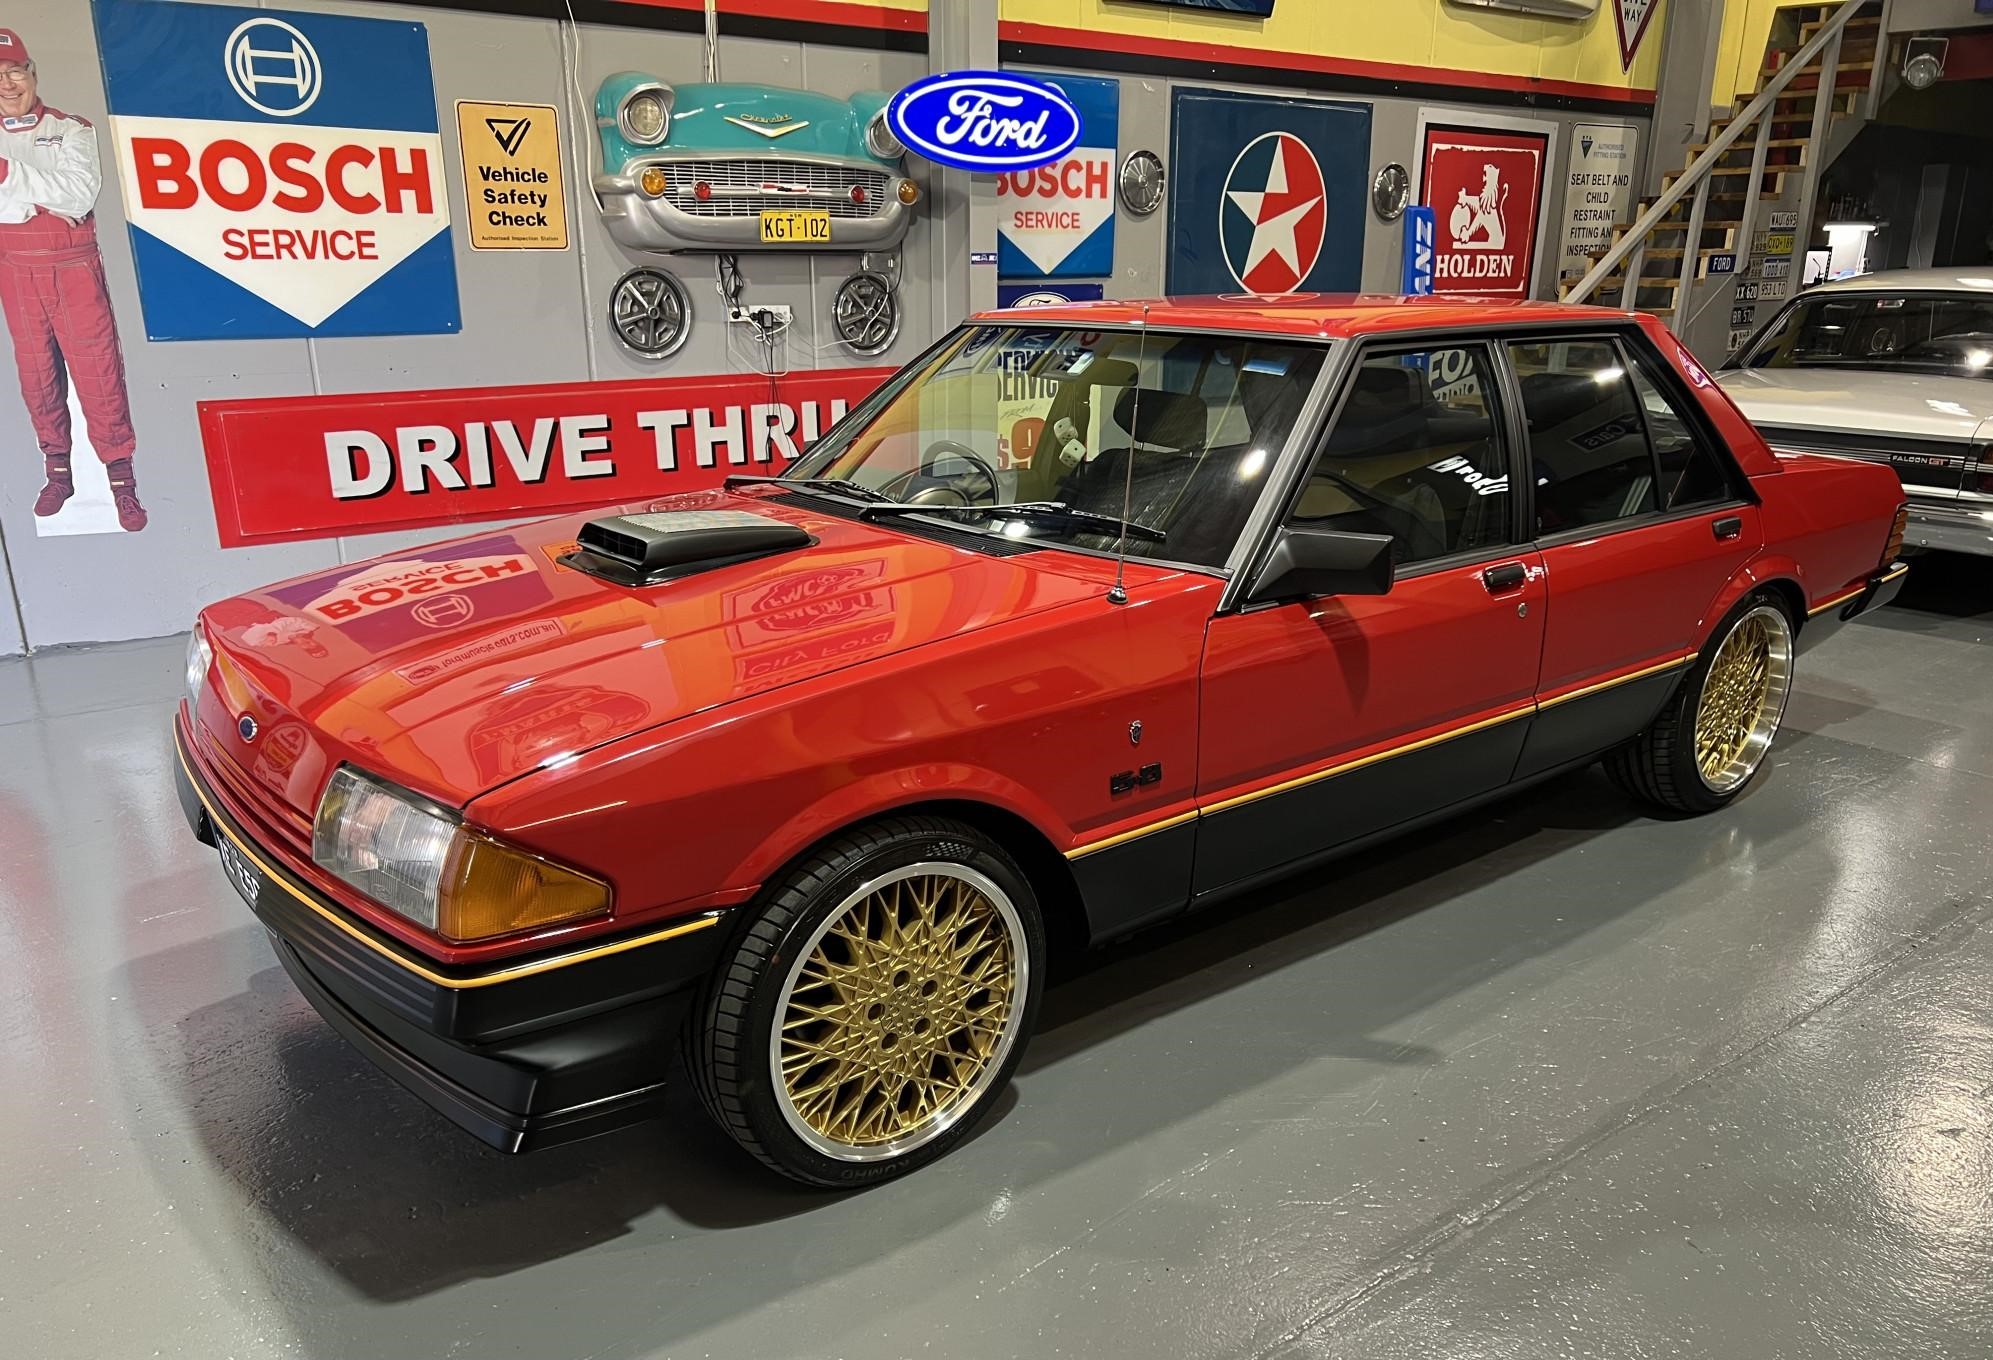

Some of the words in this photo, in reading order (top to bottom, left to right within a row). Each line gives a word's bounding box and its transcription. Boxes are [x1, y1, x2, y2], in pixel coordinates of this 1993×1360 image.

[1624, 8, 1643, 22] WAY
[936, 90, 1050, 149] Ford
[131, 137, 433, 214] BOSCH
[478, 165, 549, 184] Vehicle
[1570, 173, 1590, 186] SEAT
[1591, 174, 1611, 186] BELT
[1612, 174, 1629, 186] AND
[483, 188, 548, 209] Safety
[1586, 191, 1609, 204] CHILD
[488, 210, 548, 226] Check
[1014, 211, 1081, 229] SERVICE
[1573, 209, 1616, 222] RESTRAINT
[1570, 226, 1599, 239] FITTING
[1600, 226, 1612, 239] AN
[222, 228, 379, 260] SERVICE
[1434, 254, 1514, 279] HOLDEN
[1712, 257, 1731, 271] FORD
[324, 413, 614, 498] DRIVE
[637, 399, 846, 470] THRU
[1892, 455, 1928, 464] FALCON
[1928, 457, 1949, 466] GT
